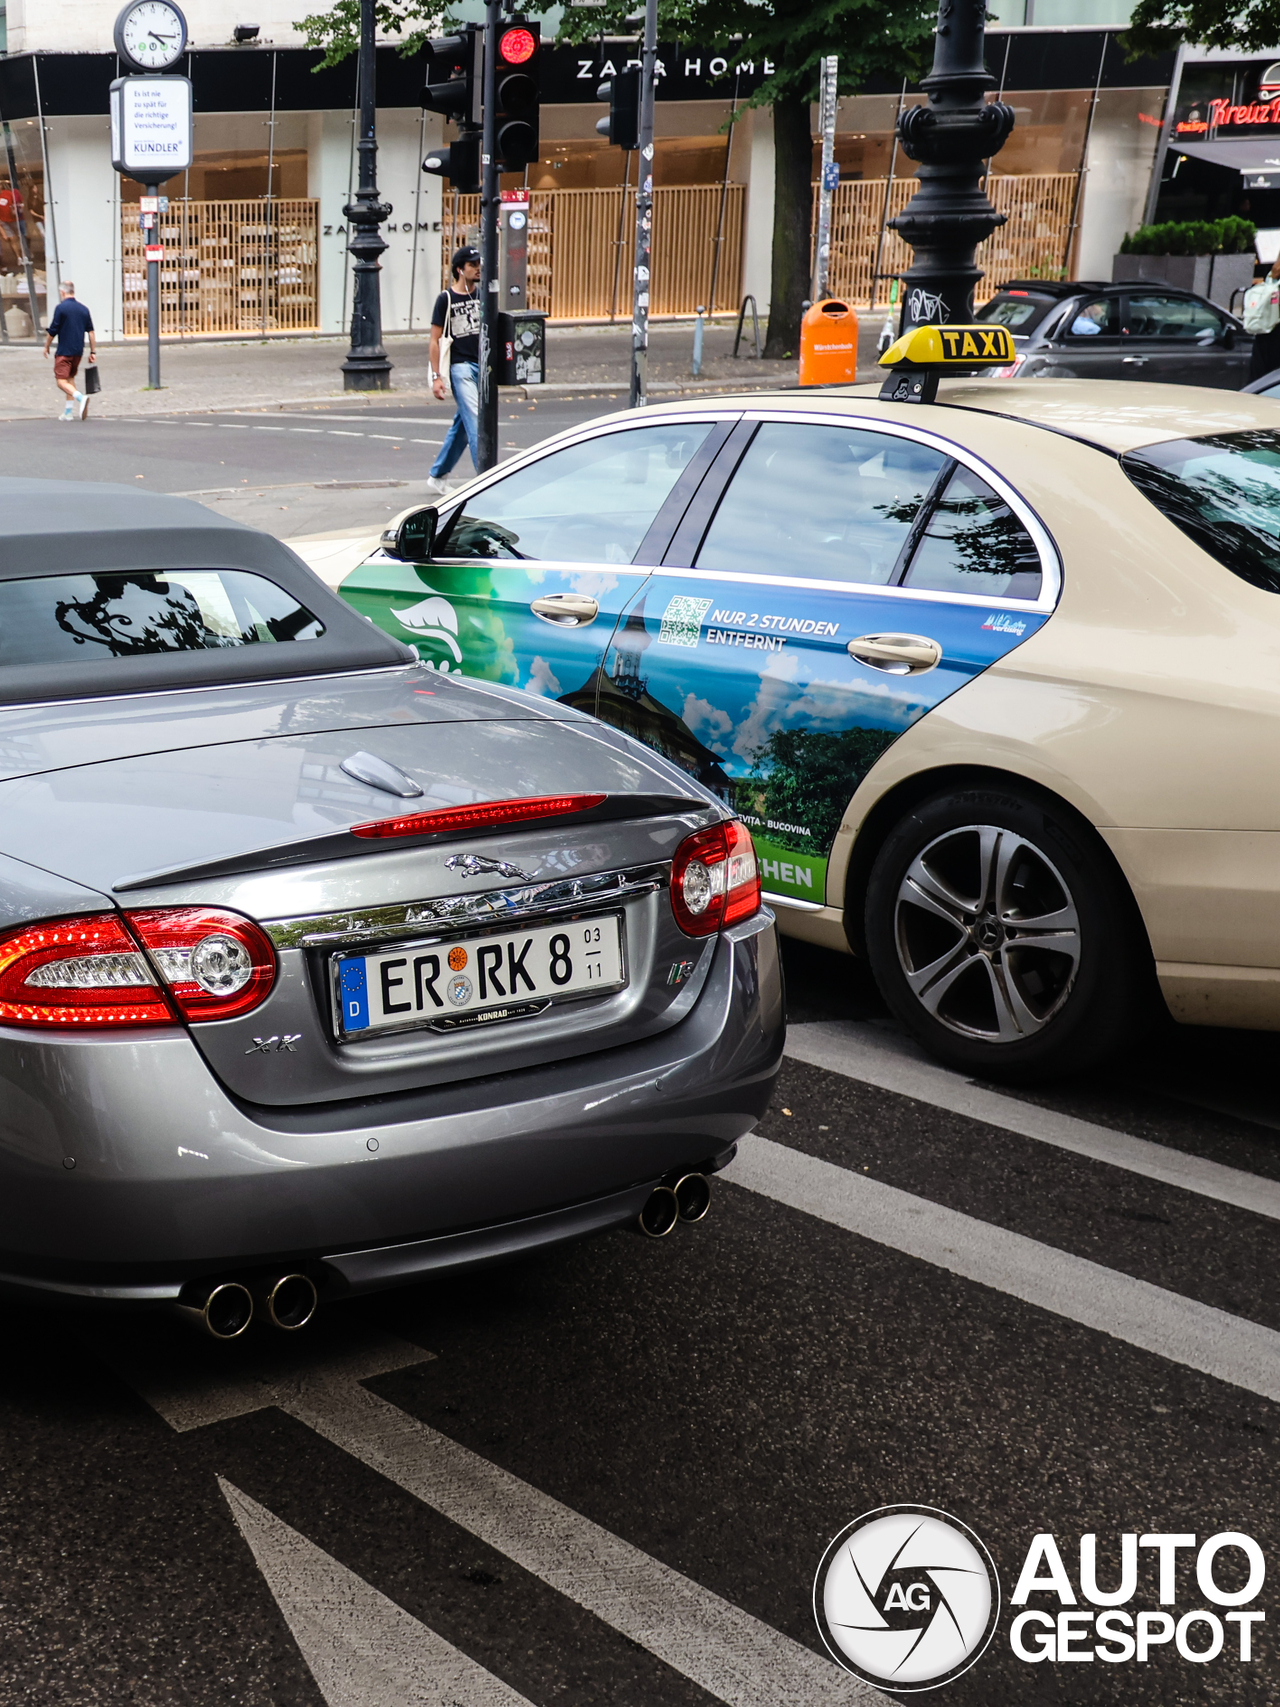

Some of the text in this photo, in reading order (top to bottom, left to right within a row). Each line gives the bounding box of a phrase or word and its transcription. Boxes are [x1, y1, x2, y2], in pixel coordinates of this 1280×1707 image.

[684, 57, 776, 77] HOME
[143, 101, 156, 109] spät
[145, 112, 169, 120] richtige
[134, 122, 177, 130] Versicherung!
[387, 222, 442, 233] HOME
[814, 342, 853, 351] Würstchenbude
[943, 331, 1007, 357] TAXI
[711, 609, 840, 637] NUR 2 STUNDEN
[705, 628, 787, 652] ENTFERNT
[767, 820, 812, 837] BUCOVINA
[758, 857, 813, 888] HEN
[584, 927, 601, 944] 03
[379, 932, 572, 1015] ER RK 8
[586, 962, 602, 979] 11
[349, 1000, 360, 1018] D
[477, 1009, 508, 1022] KONRAD
[244, 1034, 302, 1055] XK
